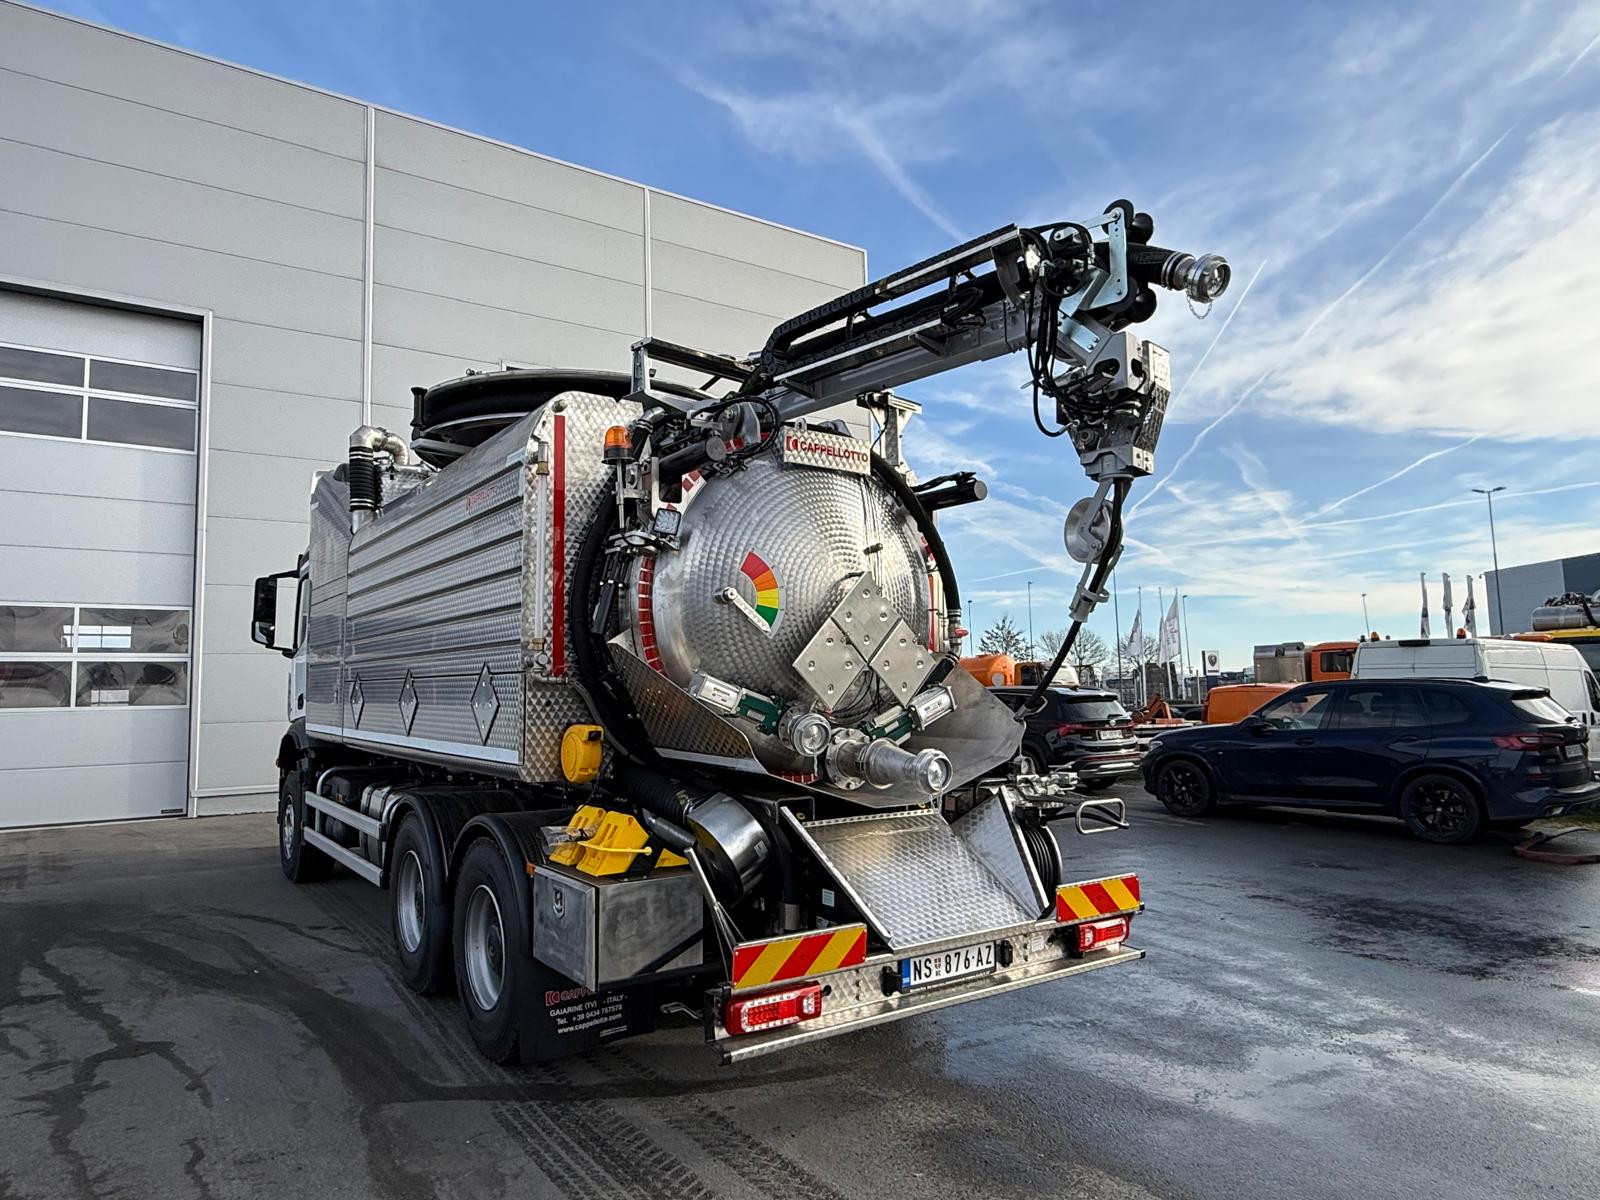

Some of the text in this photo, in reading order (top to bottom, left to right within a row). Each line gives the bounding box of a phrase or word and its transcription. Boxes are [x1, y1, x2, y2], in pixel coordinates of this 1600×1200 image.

[800, 441, 868, 462] CAPPELLOTTO
[913, 958, 932, 981] NS
[549, 1003, 584, 1017] GAIARINE
[585, 1000, 597, 1010] (TV)
[606, 994, 624, 1004] ITALY
[556, 1017, 568, 1026] Tel.
